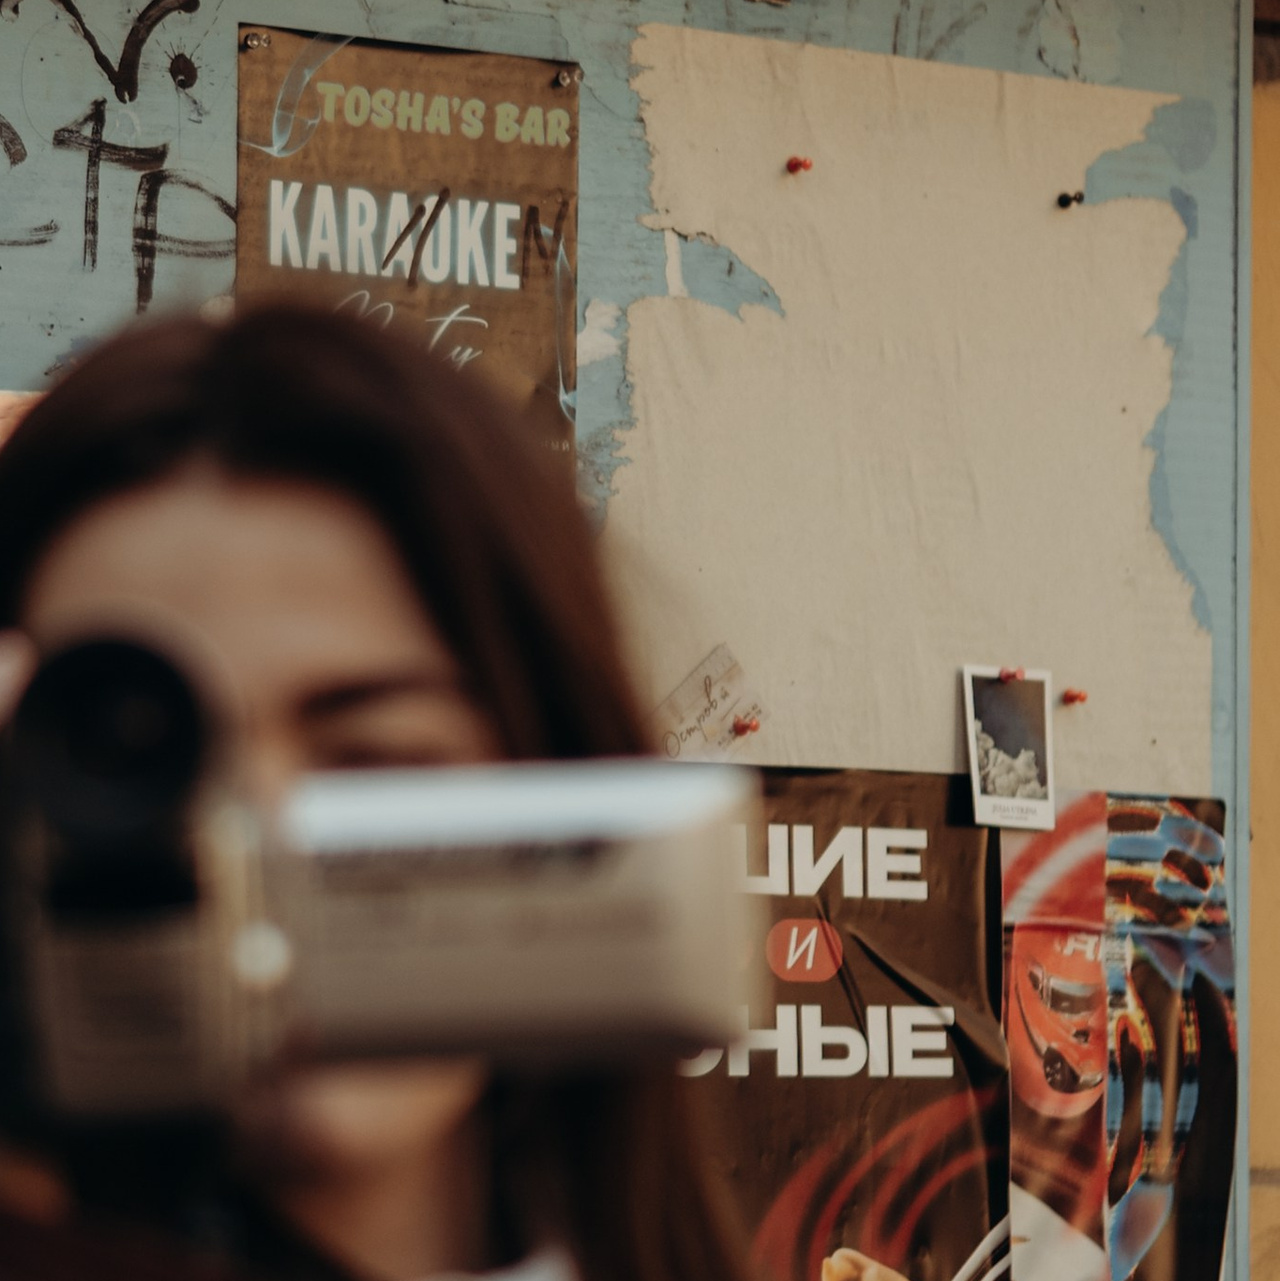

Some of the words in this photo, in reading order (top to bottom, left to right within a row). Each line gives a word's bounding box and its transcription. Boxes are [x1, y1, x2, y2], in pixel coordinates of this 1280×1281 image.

[317, 81, 486, 140] TOSHA'S
[494, 102, 570, 149] BAR
[269, 179, 521, 290] KARAOKE
[786, 927, 819, 970] И
